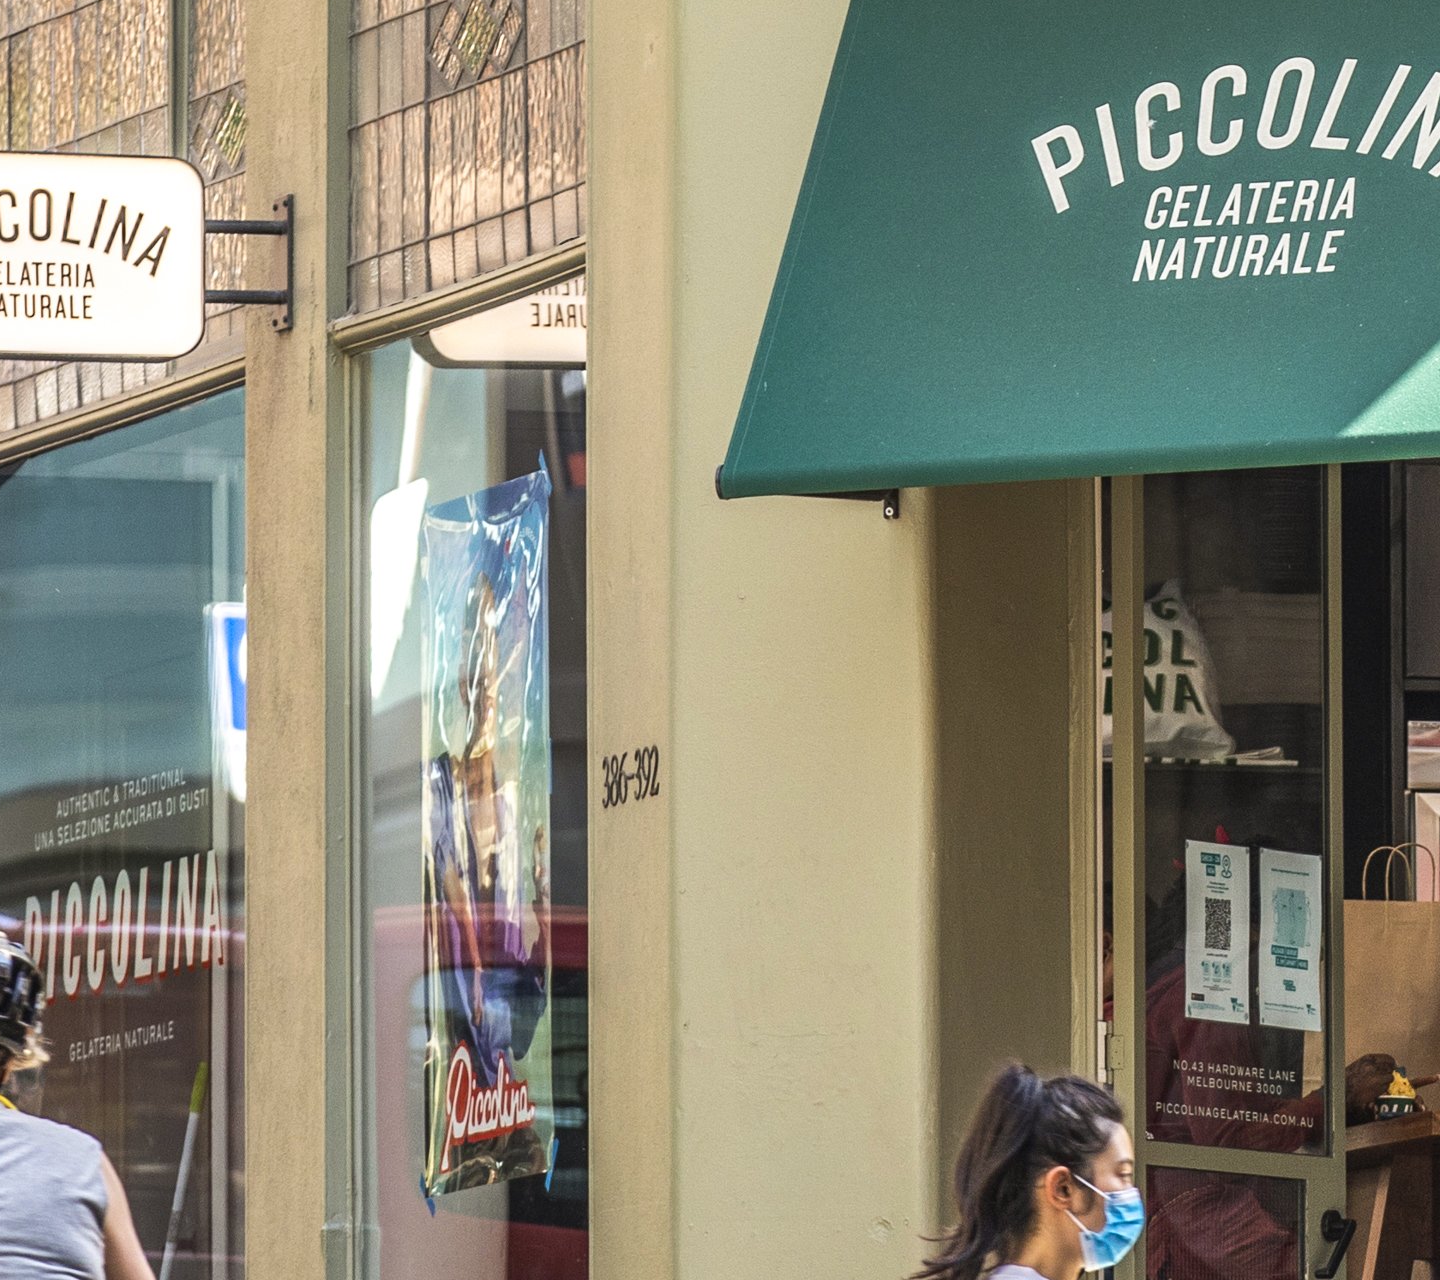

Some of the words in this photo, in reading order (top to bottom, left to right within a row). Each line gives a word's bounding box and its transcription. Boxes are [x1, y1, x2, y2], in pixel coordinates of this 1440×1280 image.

[1143, 177, 1357, 230] GELATERIA
[1132, 230, 1345, 283] NATURALE
[56, 787, 110, 819] AUTHENTIC
[113, 787, 120, 805] &
[122, 768, 186, 800] TRADITIONAL
[601, 744, 660, 809] 386-392
[34, 829, 55, 852] UNA
[57, 814, 111, 846] SELEZIONE
[113, 801, 163, 830] ACCURATA
[166, 797, 177, 816] DI
[179, 787, 209, 811] GUSTI
[24, 849, 224, 1005] PICCOLINA
[68, 1032, 121, 1062] GELATERIA
[124, 1020, 174, 1050] NATURALE
[1173, 1059, 1204, 1073] NO.43
[1207, 1062, 1265, 1079] HARDWARE
[1269, 1070, 1296, 1083] LANE
[1187, 1076, 1253, 1093] MELBOURNE
[1256, 1083, 1283, 1096] 3000
[1155, 1101, 1314, 1129] PICCOLINAGELATERIA.COM.AU
